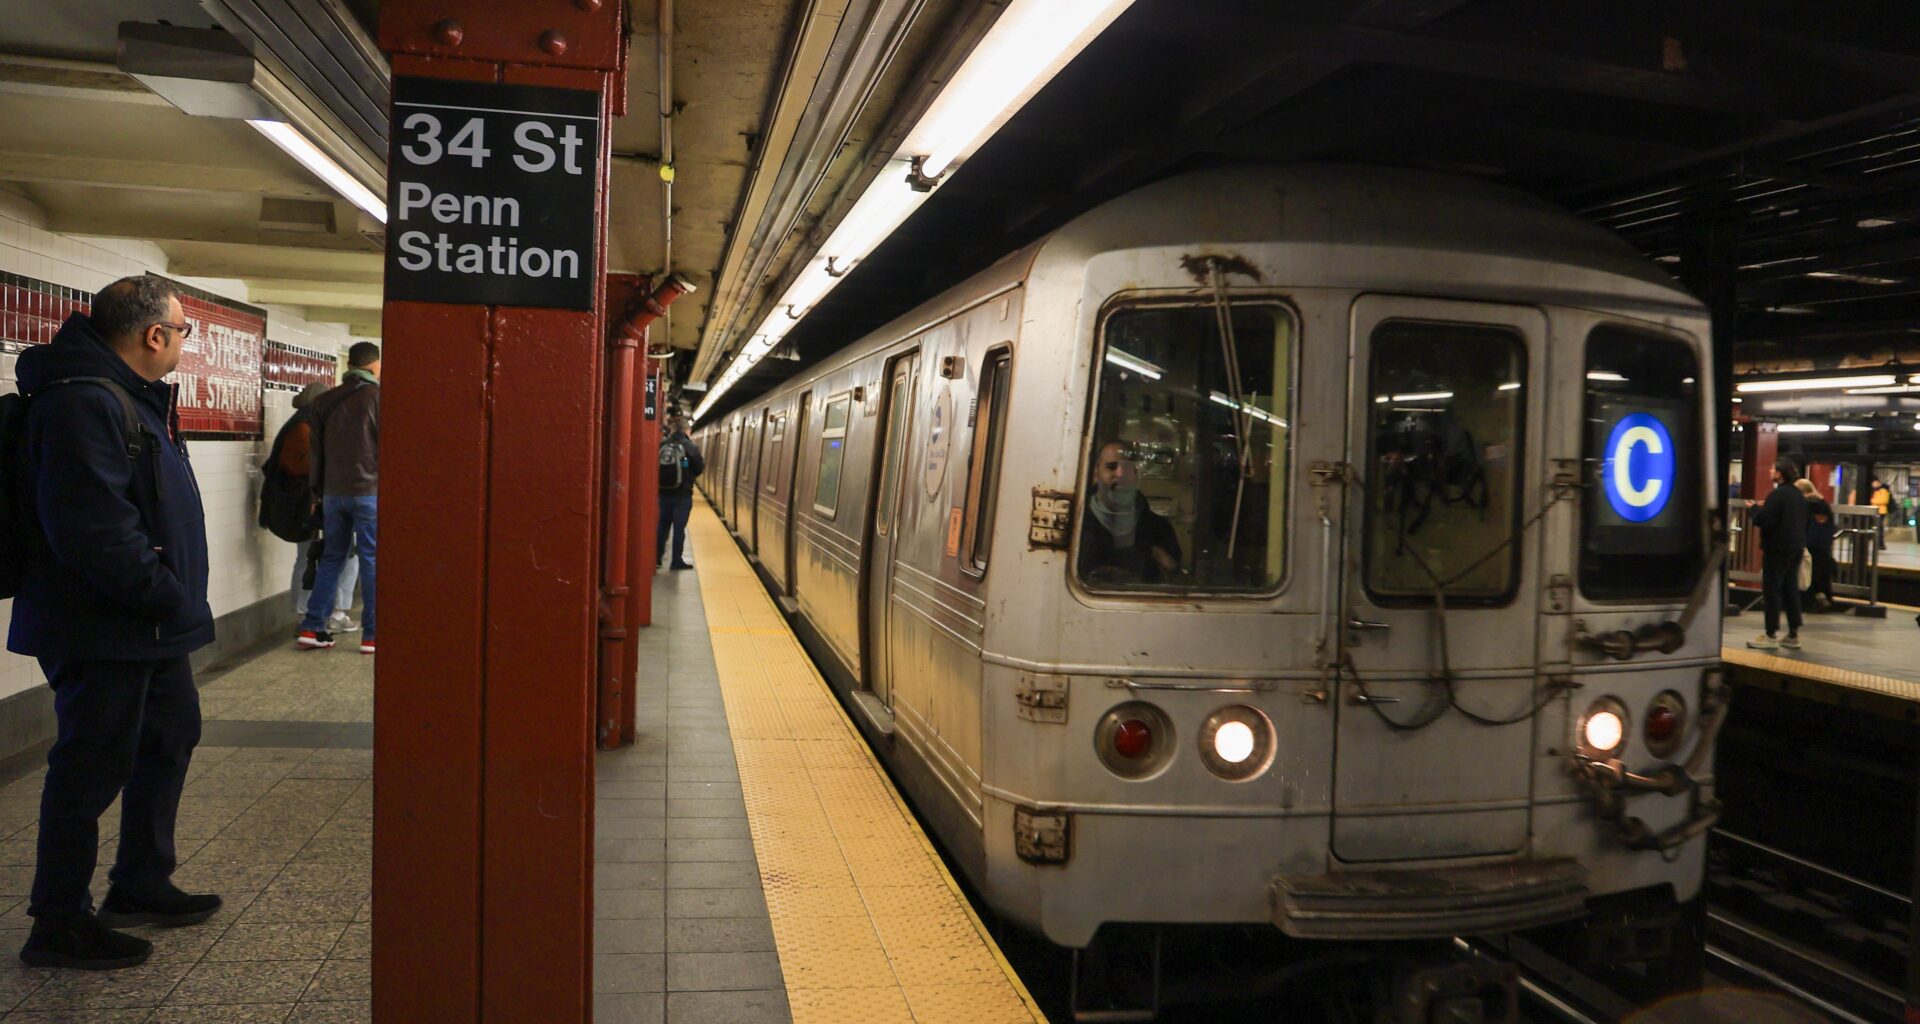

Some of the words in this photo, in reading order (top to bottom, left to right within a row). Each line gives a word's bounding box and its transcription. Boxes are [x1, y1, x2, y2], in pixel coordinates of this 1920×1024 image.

[401, 113, 491, 168] 34
[512, 120, 583, 175] St
[399, 181, 520, 227] Penn
[398, 230, 579, 279] Station
[206, 323, 257, 371] STREET
[206, 374, 256, 412] STATION
[1614, 426, 1663, 507] C
